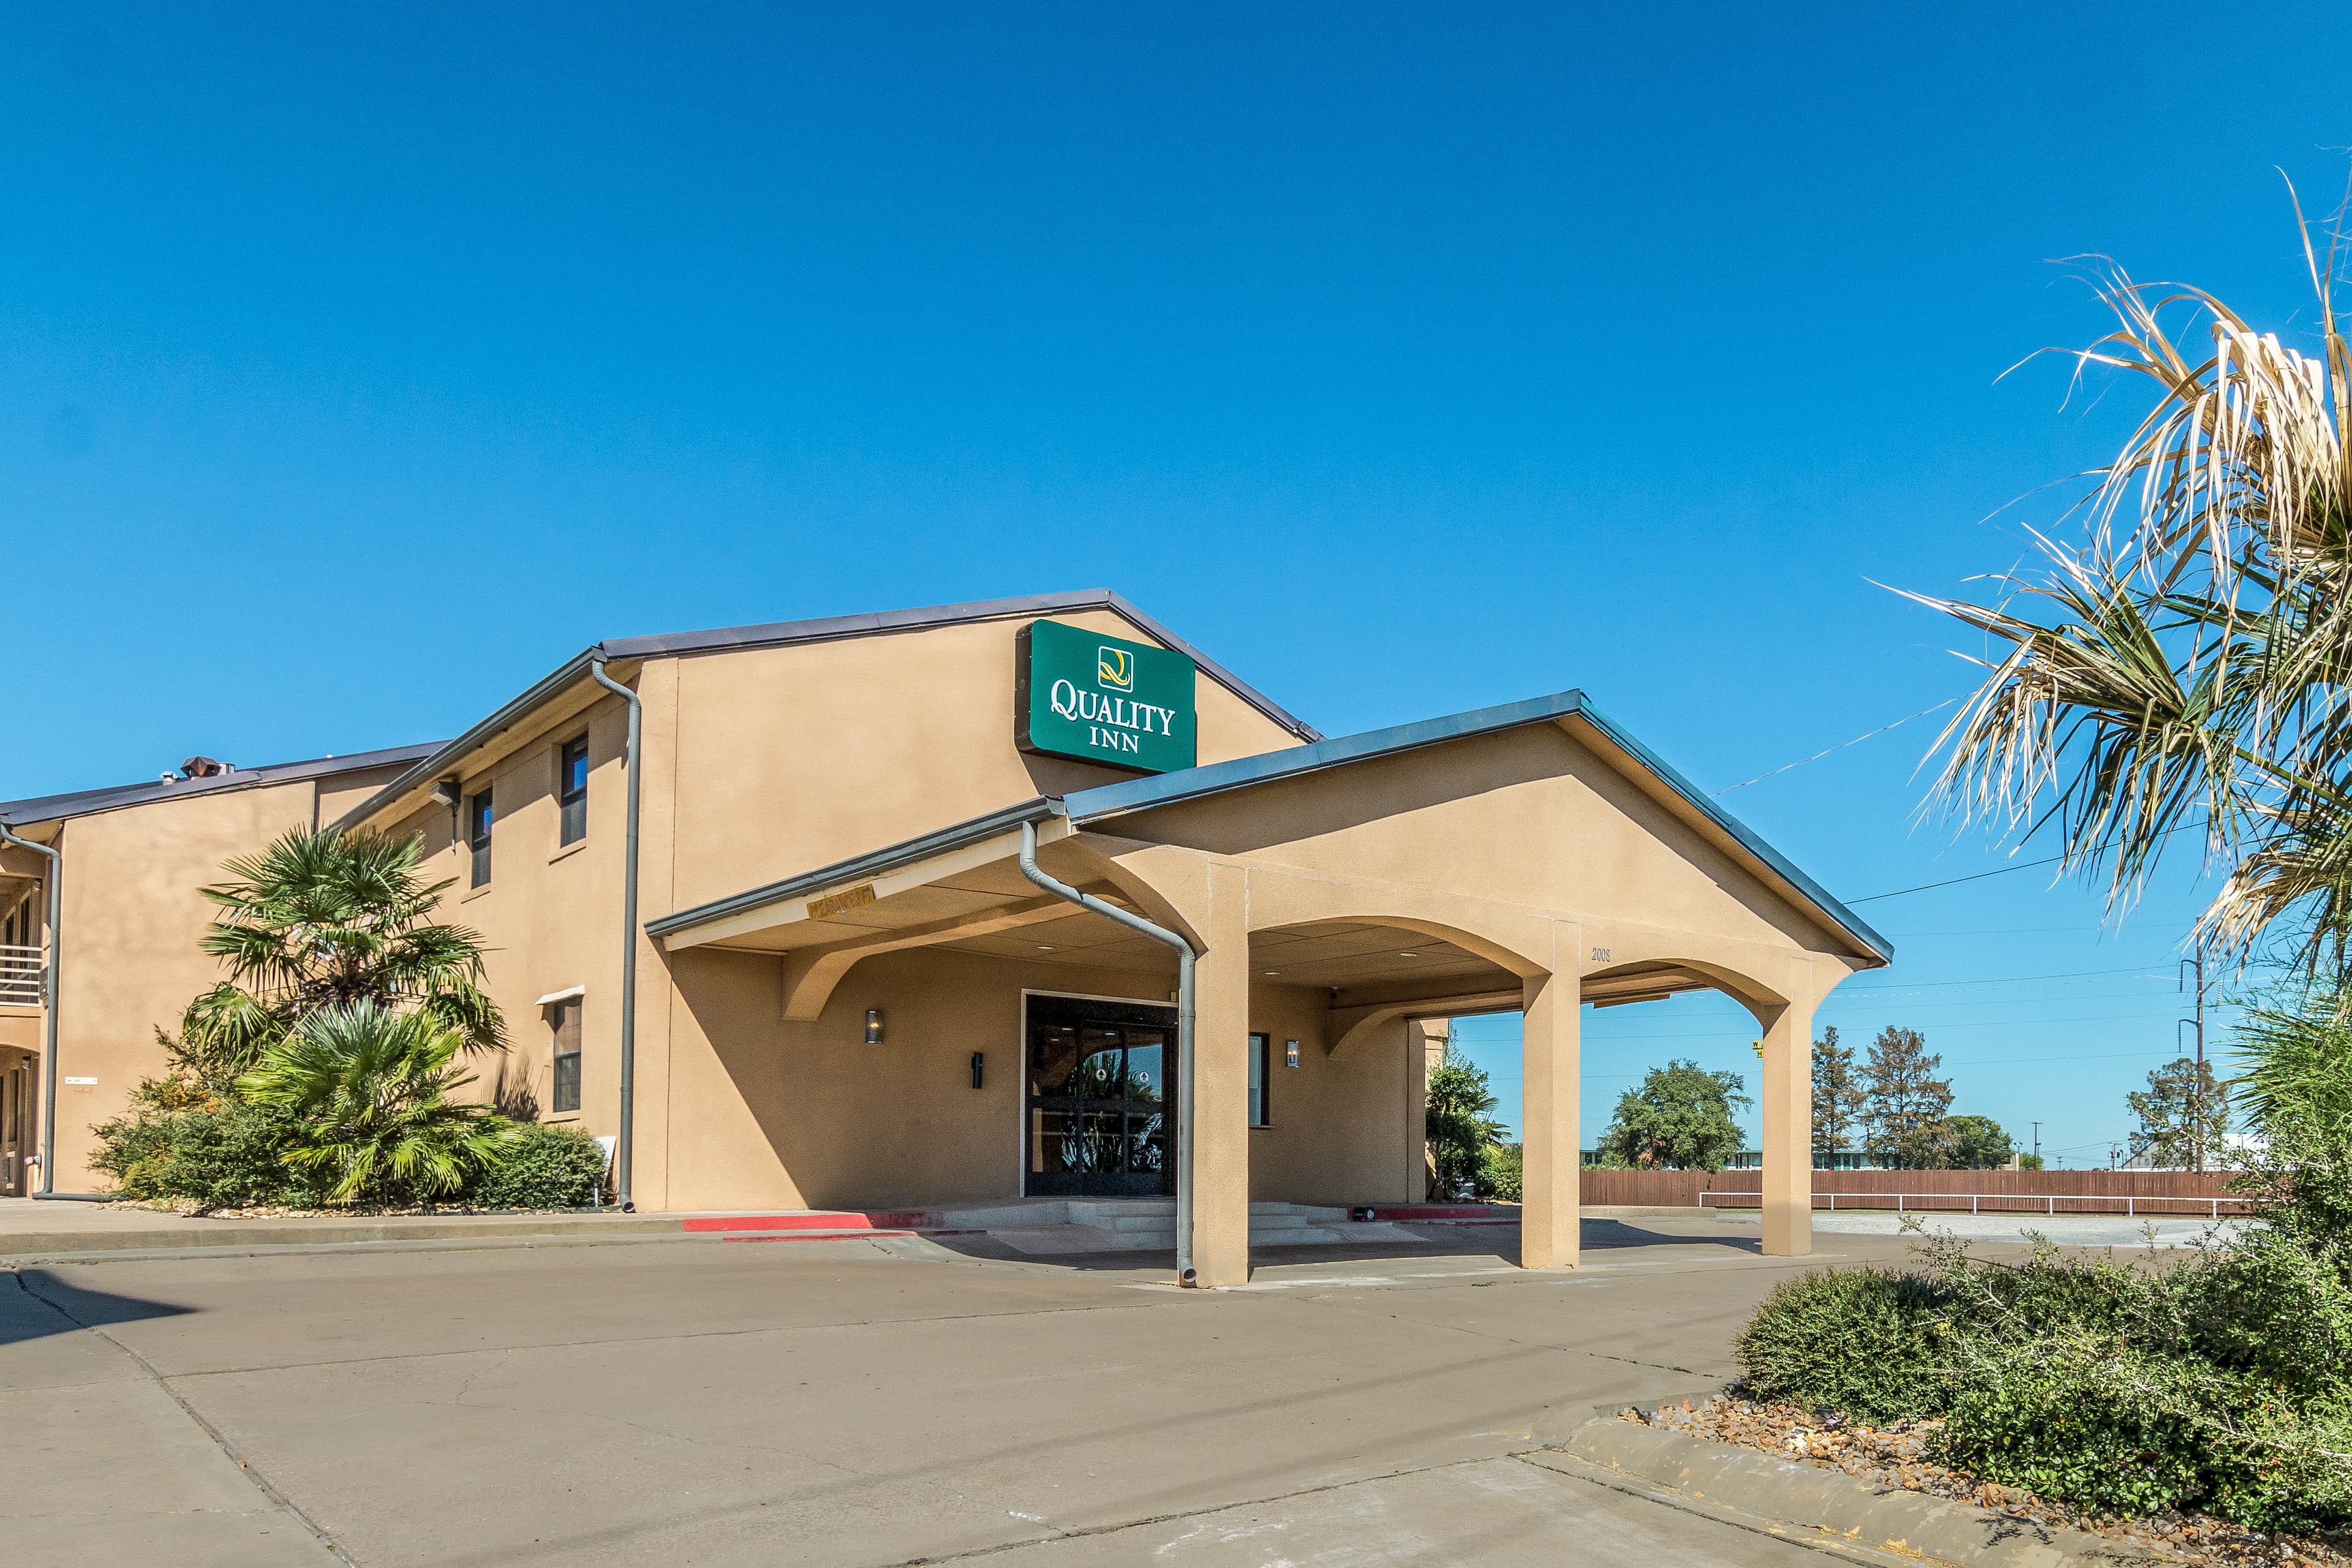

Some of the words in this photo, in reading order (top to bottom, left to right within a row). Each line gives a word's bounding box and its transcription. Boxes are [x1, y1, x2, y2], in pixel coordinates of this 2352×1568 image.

[1050, 679, 1176, 736] QUALITY
[1090, 725, 1140, 755] INN
[1591, 947, 1611, 962] 2008
